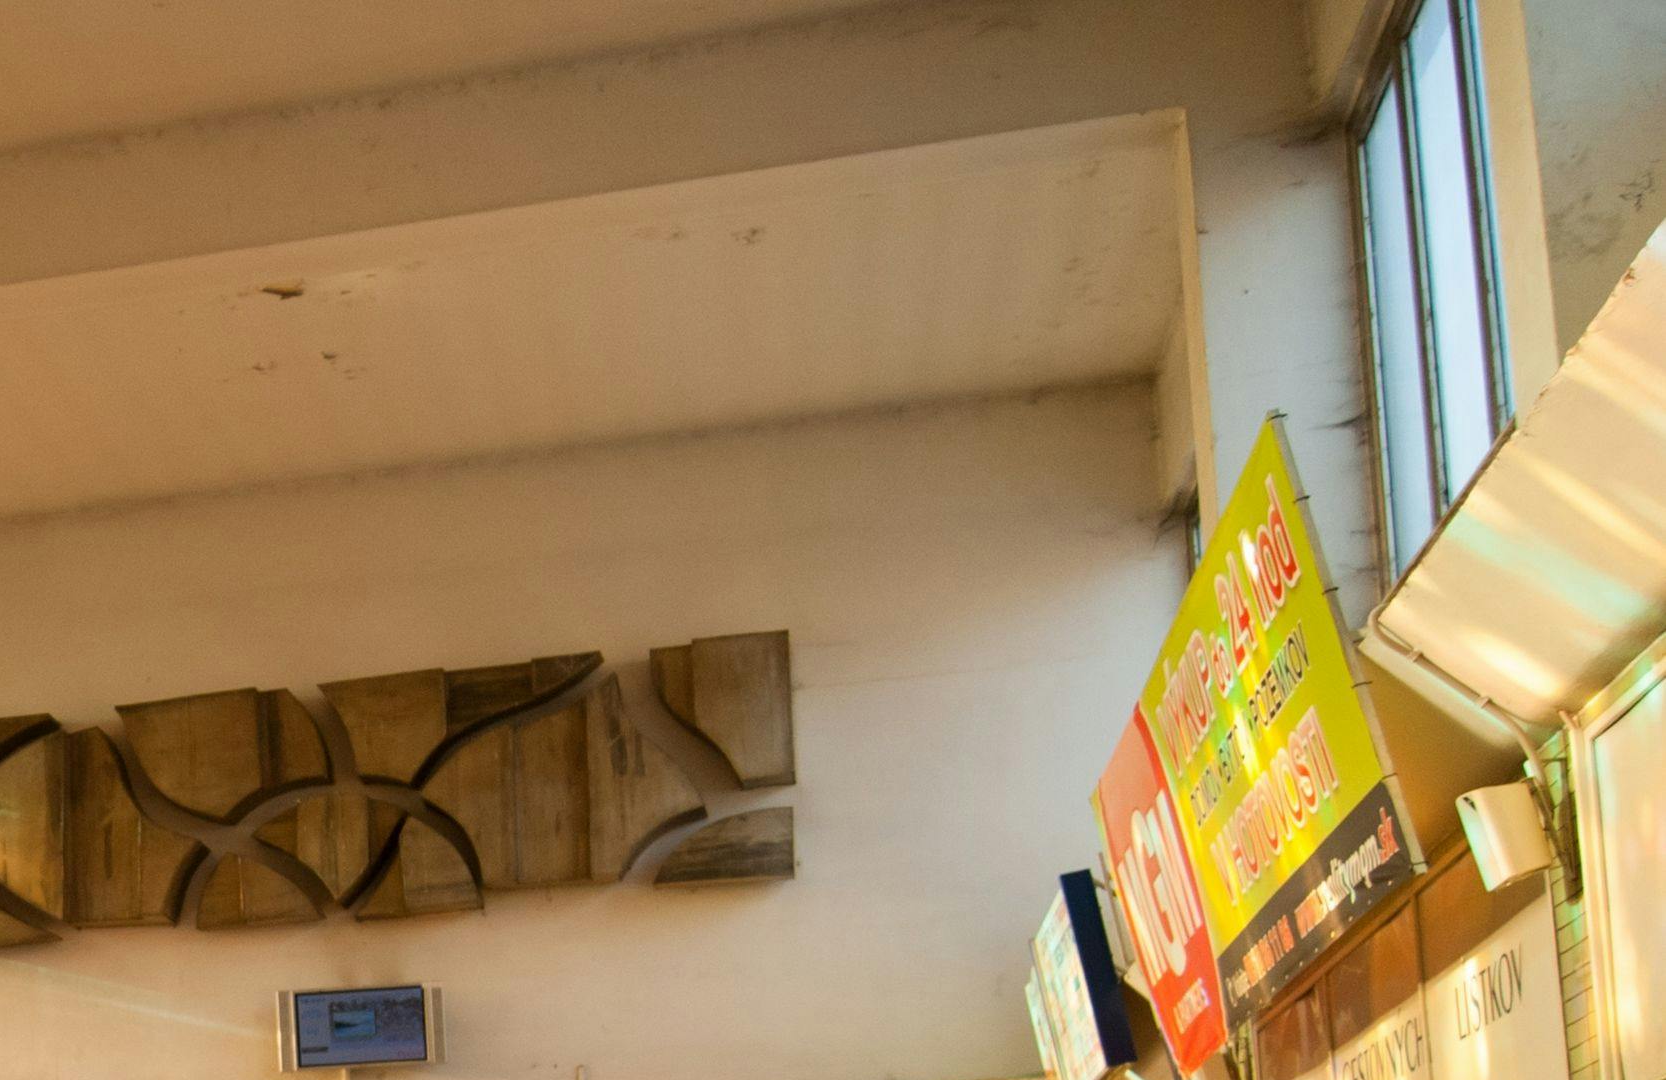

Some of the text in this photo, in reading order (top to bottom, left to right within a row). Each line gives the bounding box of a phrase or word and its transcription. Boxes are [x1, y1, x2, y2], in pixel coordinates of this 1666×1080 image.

[1214, 550, 1259, 677] 24
[1238, 472, 1302, 632] hod
[1248, 619, 1311, 739] POZEMKOV
[1223, 704, 1340, 895] HOTOVOSTI
